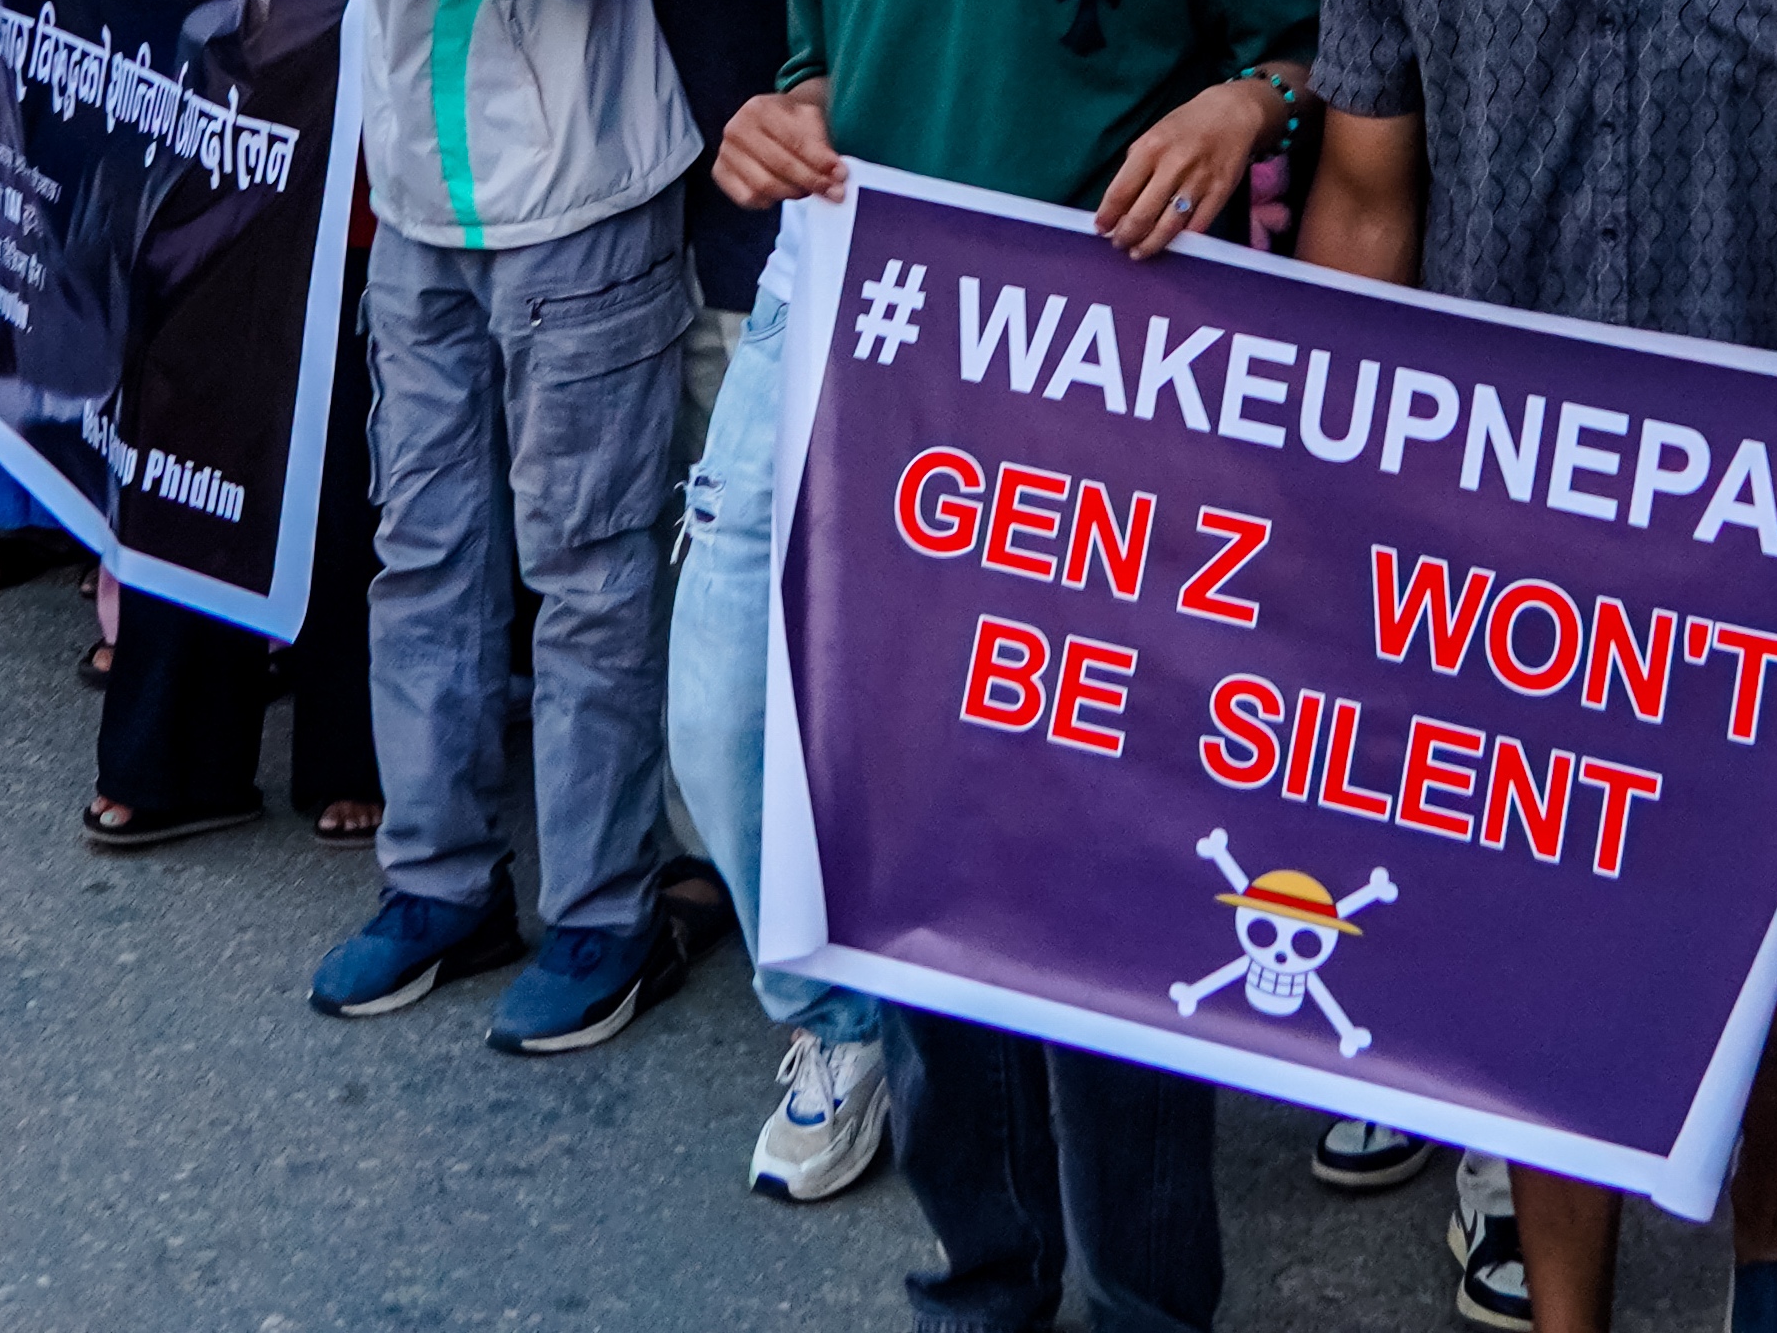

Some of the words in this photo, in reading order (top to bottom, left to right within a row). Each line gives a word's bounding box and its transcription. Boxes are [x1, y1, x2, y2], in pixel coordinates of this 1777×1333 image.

[141, 447, 246, 524] Phidim
[893, 444, 1159, 603] GEN
[1176, 505, 1273, 628] Z
[959, 614, 1139, 760] BE
[1199, 673, 1662, 880] SILENT
